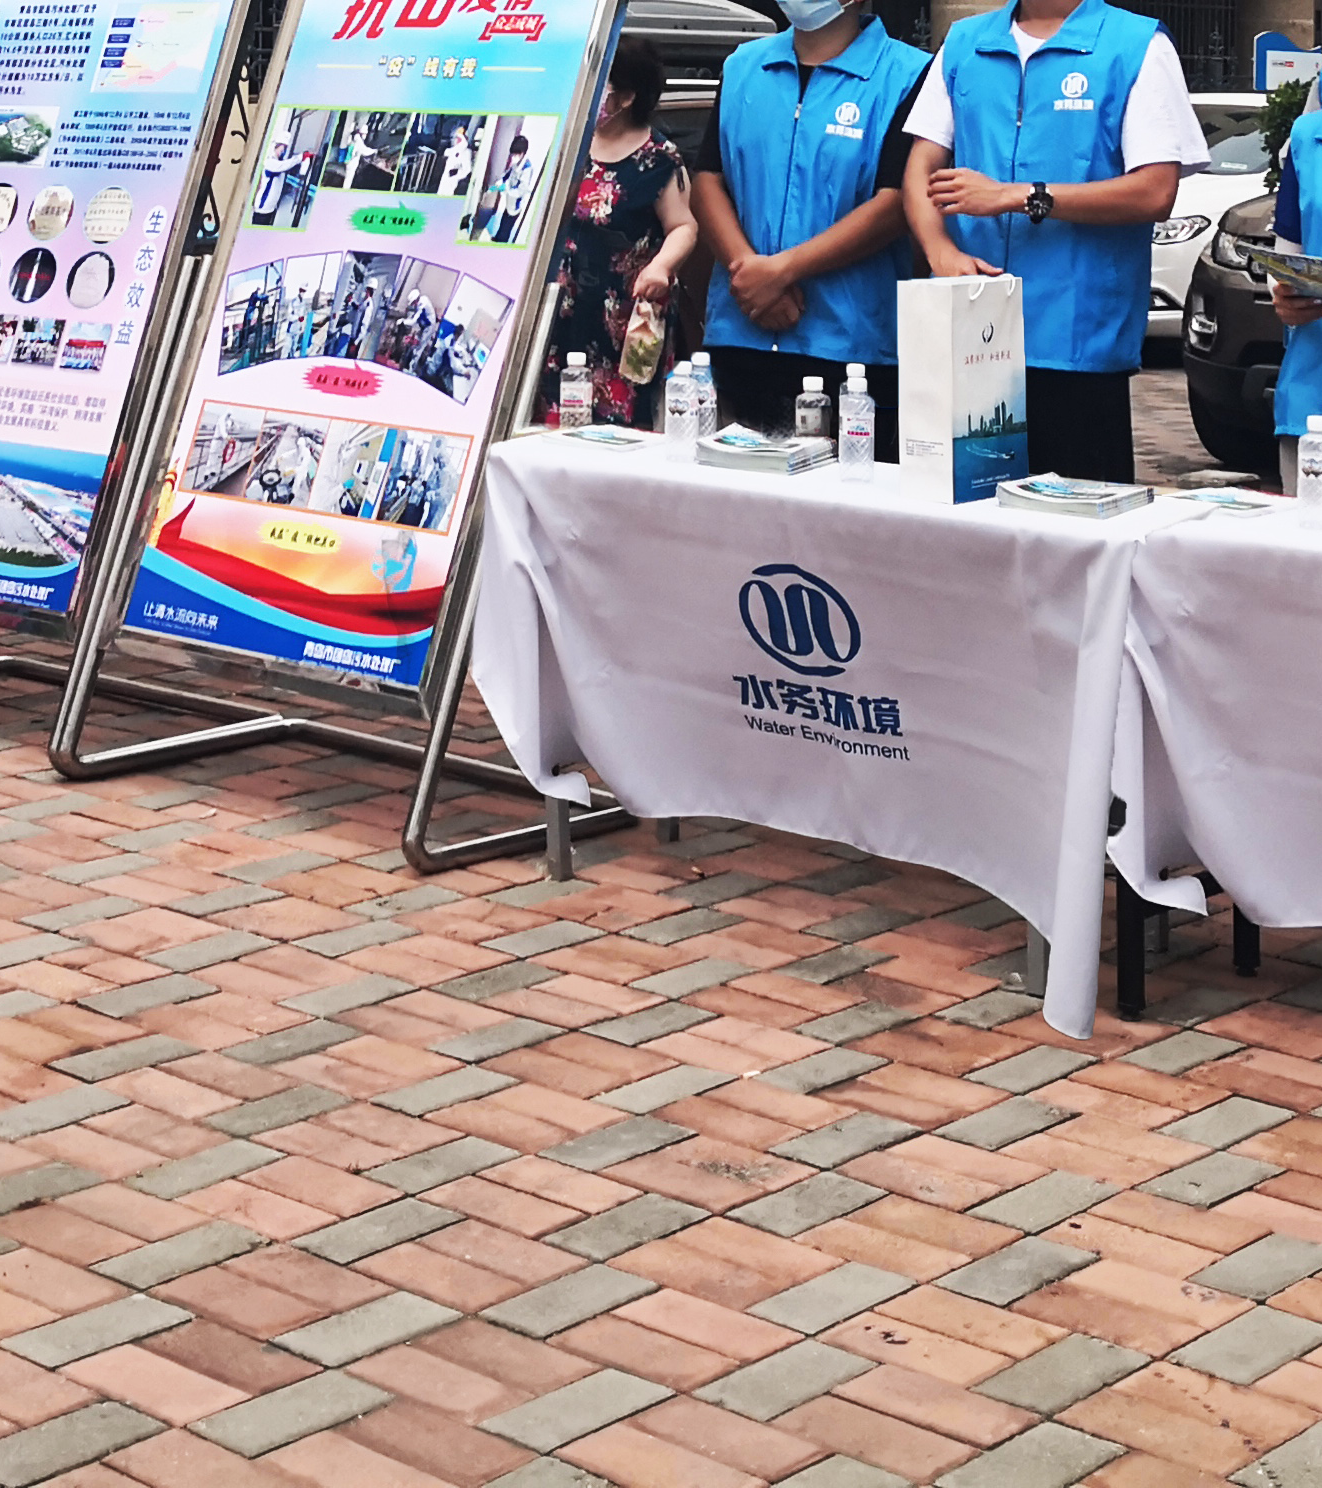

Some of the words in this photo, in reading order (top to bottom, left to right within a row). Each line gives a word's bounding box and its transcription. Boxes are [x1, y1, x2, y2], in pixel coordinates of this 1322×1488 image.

[114, 210, 165, 345] 生态效益
[733, 674, 904, 737] 水务环境
[744, 715, 796, 737] Water
[801, 725, 911, 761] Environment
